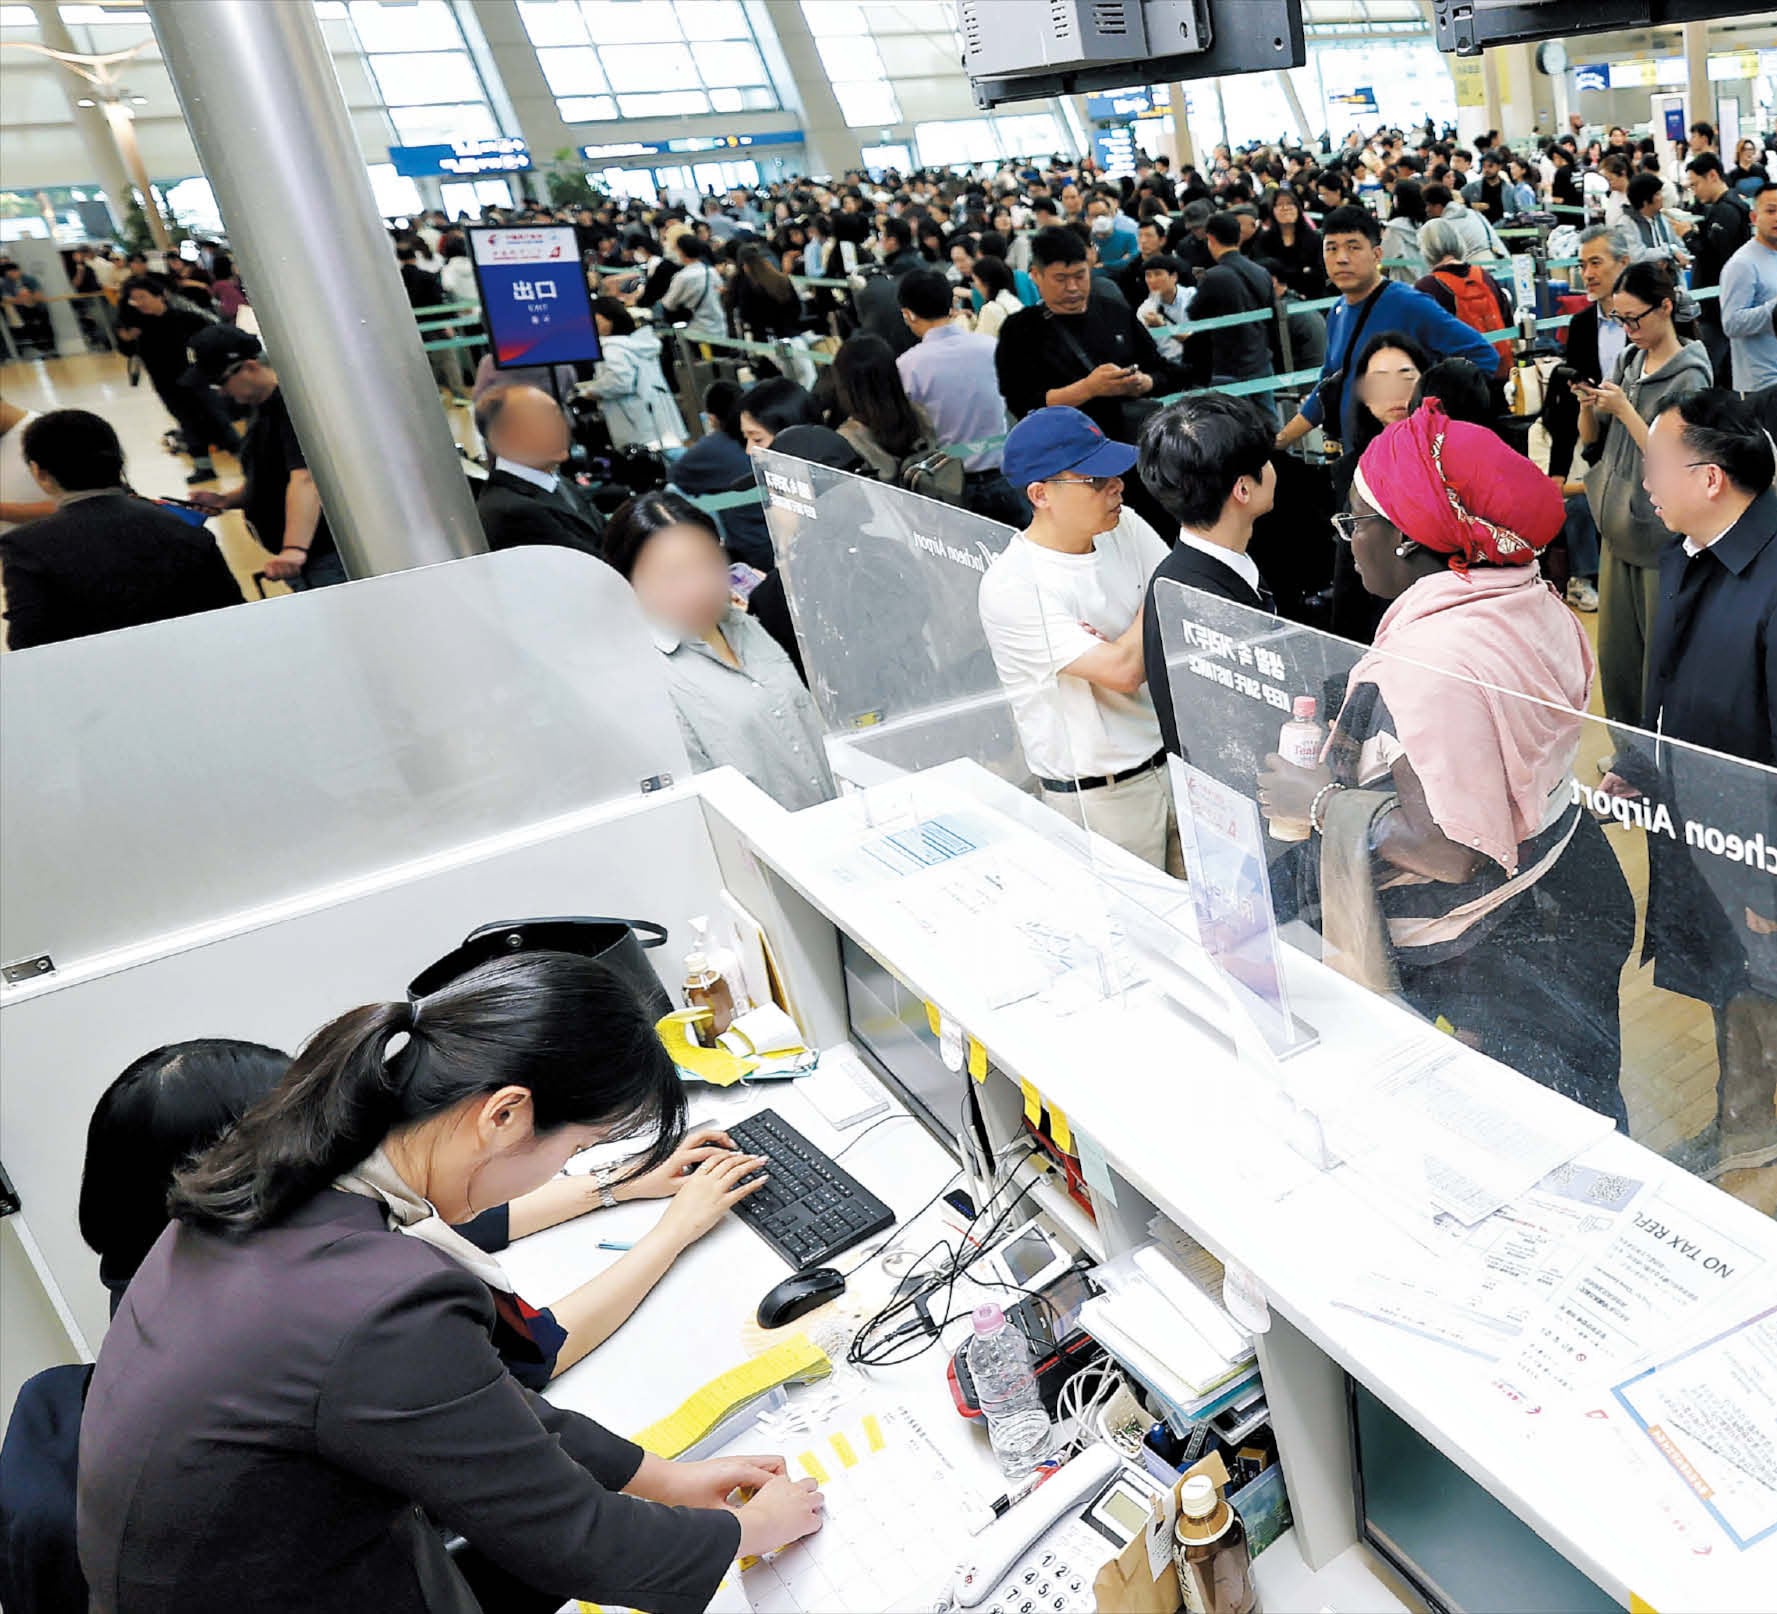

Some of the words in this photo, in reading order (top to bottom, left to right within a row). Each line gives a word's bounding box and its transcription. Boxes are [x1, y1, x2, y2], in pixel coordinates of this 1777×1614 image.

[512, 280, 558, 301] 出口
[1666, 1234, 1702, 1261] TAX
[1702, 1256, 1735, 1279] NO
[1042, 1555, 1053, 1566] 1
[1055, 1565, 1067, 1577] 2
[1024, 1572, 1036, 1584] 4
[1006, 1588, 1018, 1600] 7
[1038, 1583, 1049, 1595] 5
[1020, 1601, 1032, 1613] 8
[1053, 1596, 1064, 1609] 6
